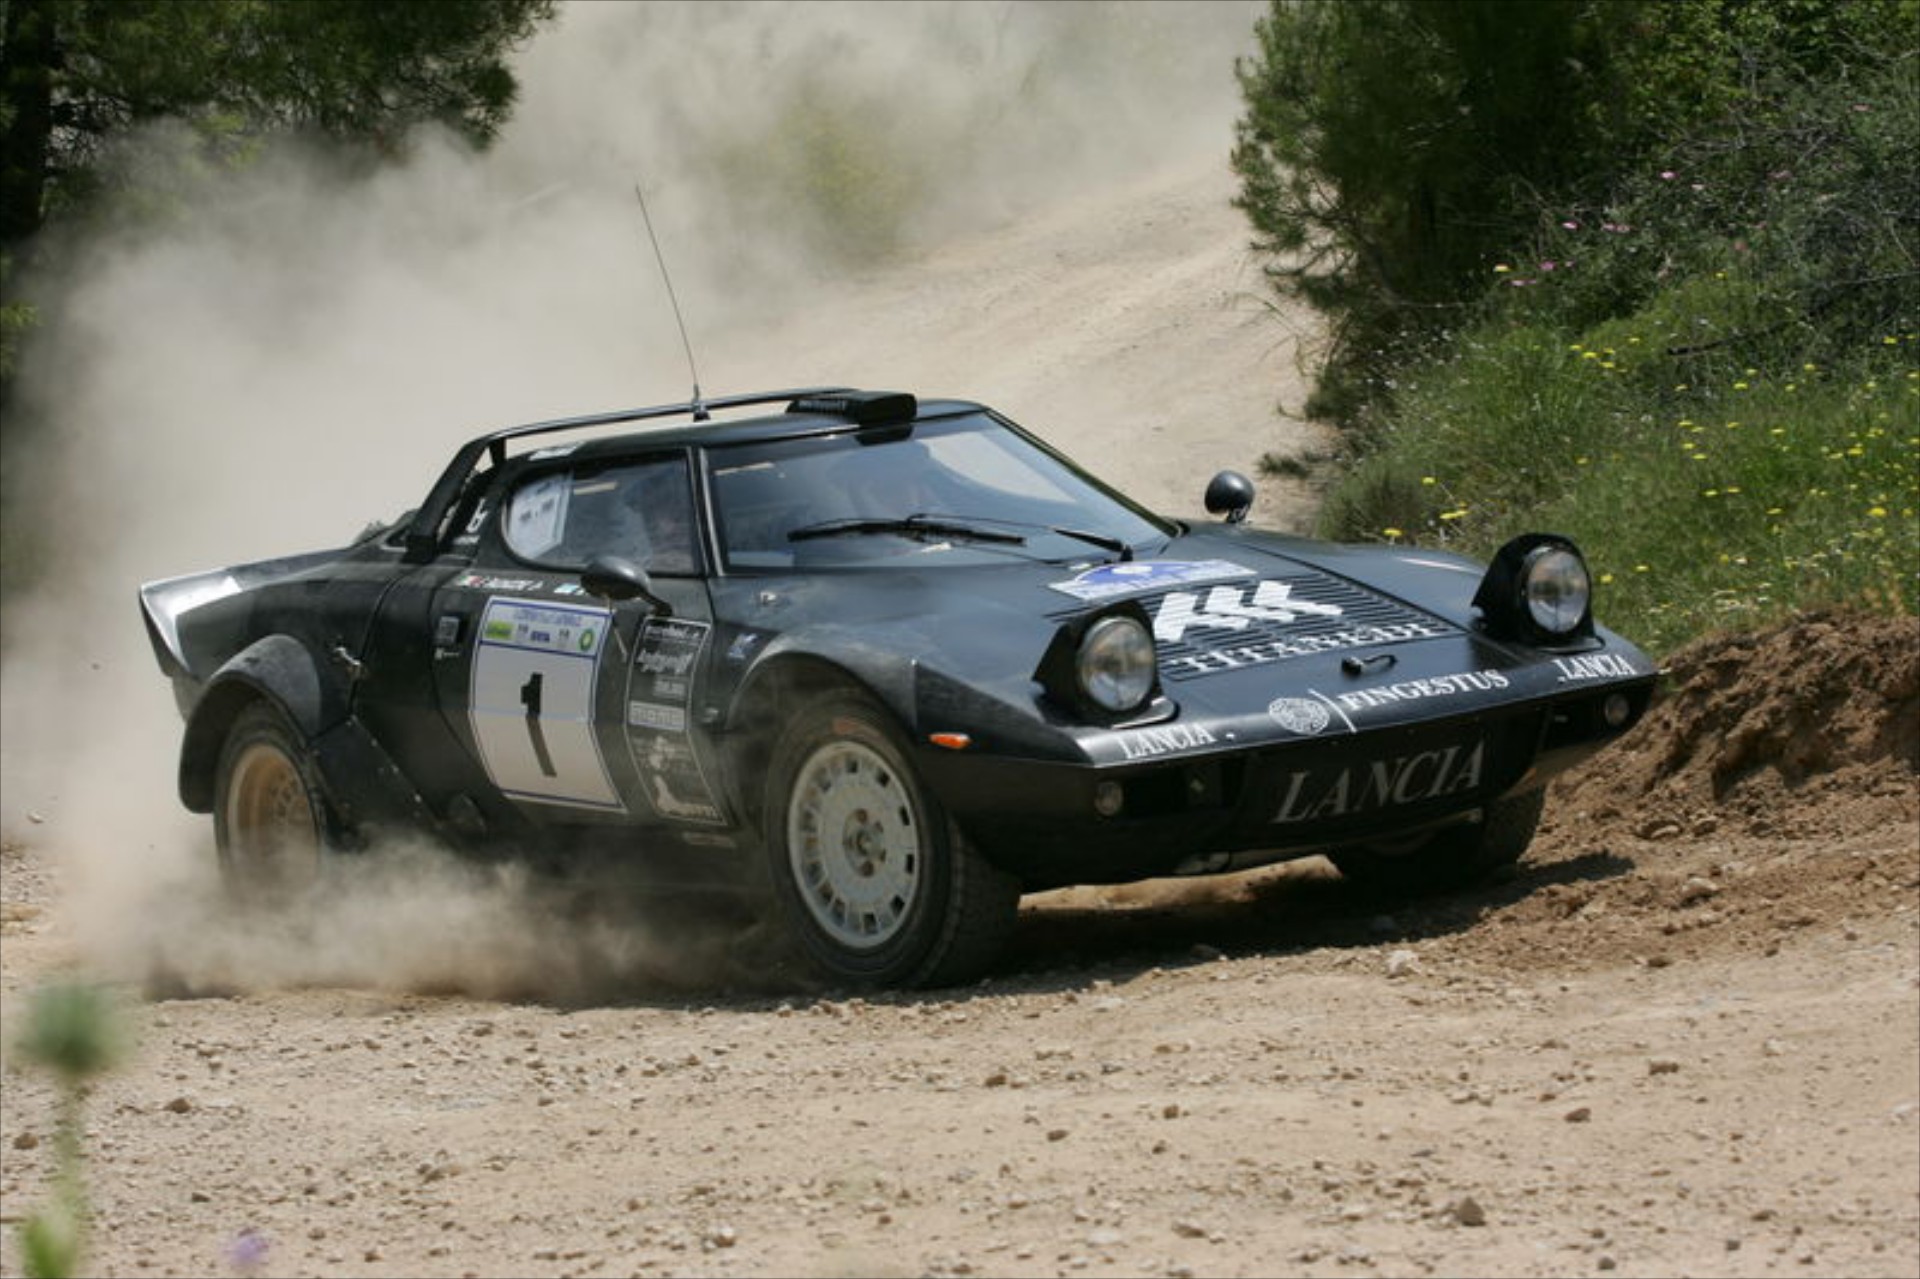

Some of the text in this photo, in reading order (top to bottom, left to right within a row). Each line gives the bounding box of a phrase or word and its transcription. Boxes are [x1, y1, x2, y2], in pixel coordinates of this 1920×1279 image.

[1553, 655, 1637, 681] LANCIA
[1336, 669, 1509, 710] FINGESTUS
[521, 672, 558, 778] 1
[1119, 723, 1215, 760] LANCIA
[1275, 742, 1483, 823] LANCIA
